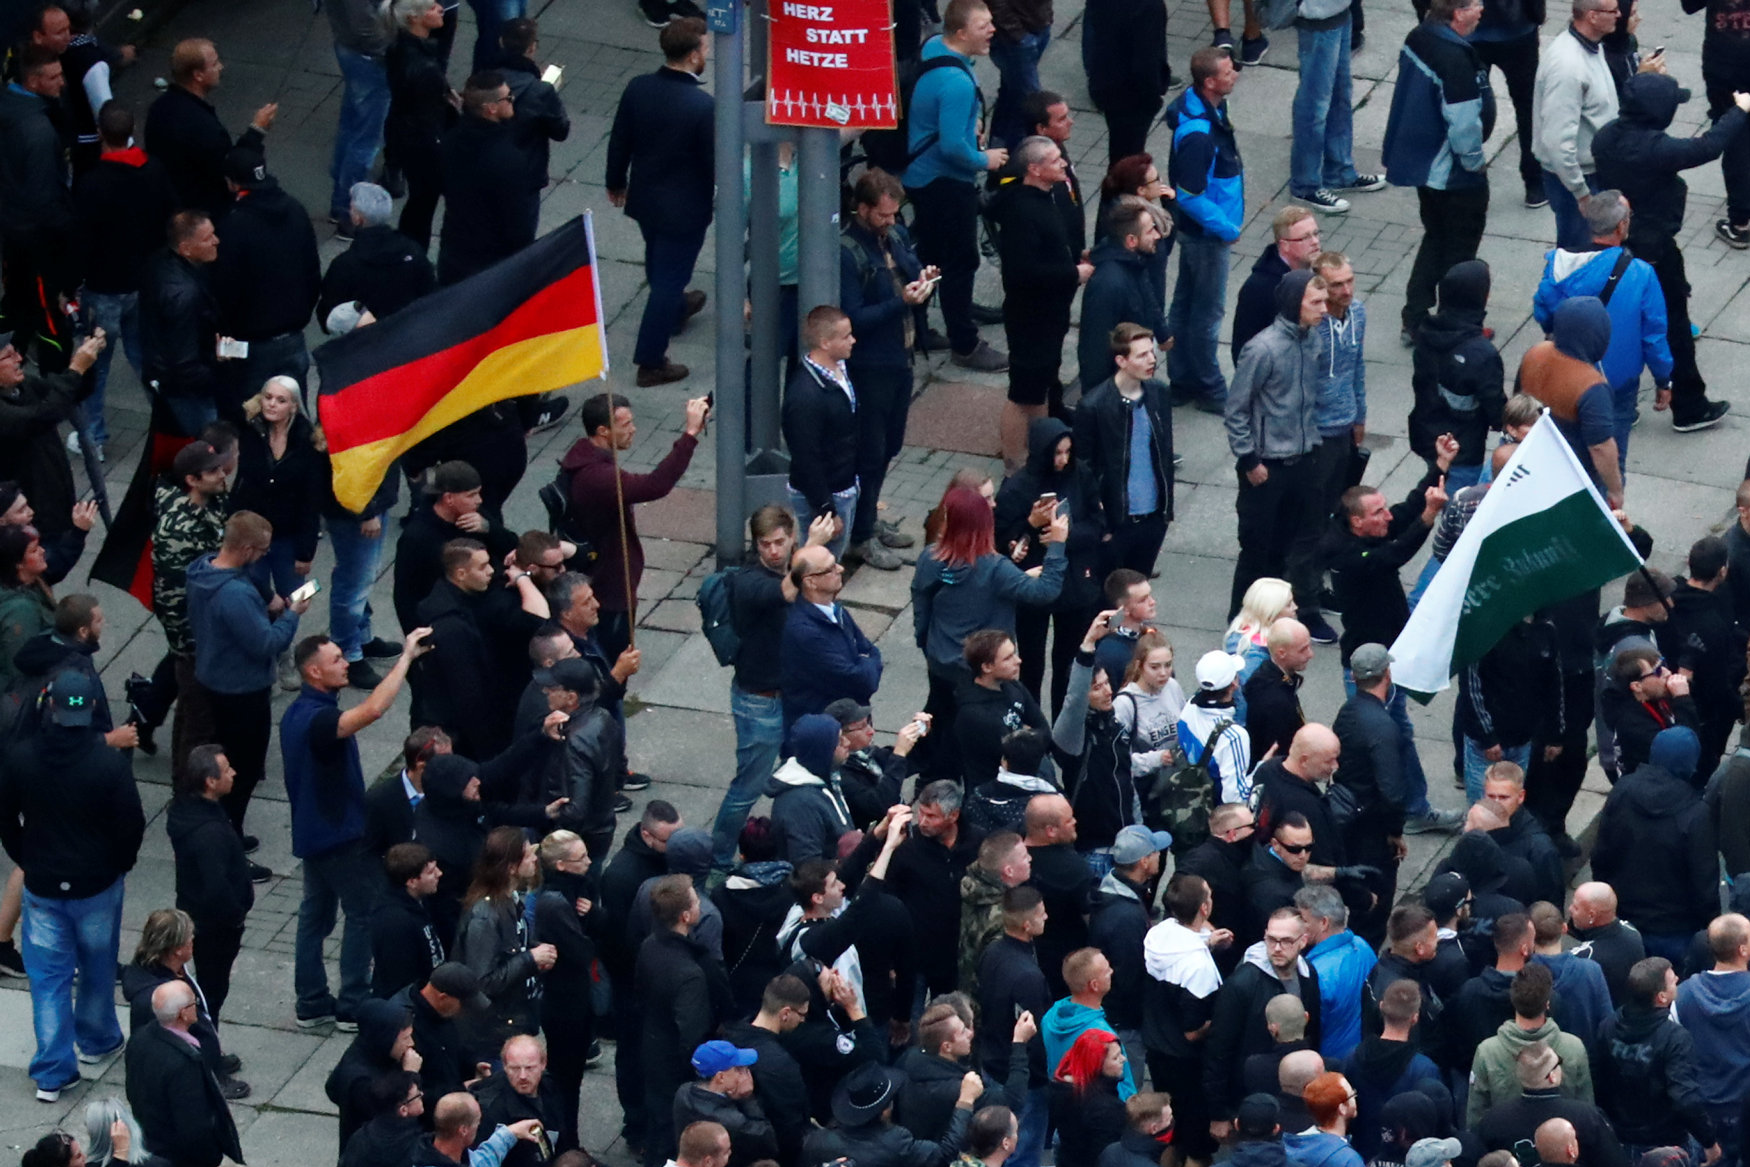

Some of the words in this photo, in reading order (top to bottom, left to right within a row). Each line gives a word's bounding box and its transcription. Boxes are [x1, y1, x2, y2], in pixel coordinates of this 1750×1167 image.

[783, 2, 834, 21] HERZ
[806, 28, 868, 44] STATT
[786, 48, 848, 68] HETZE
